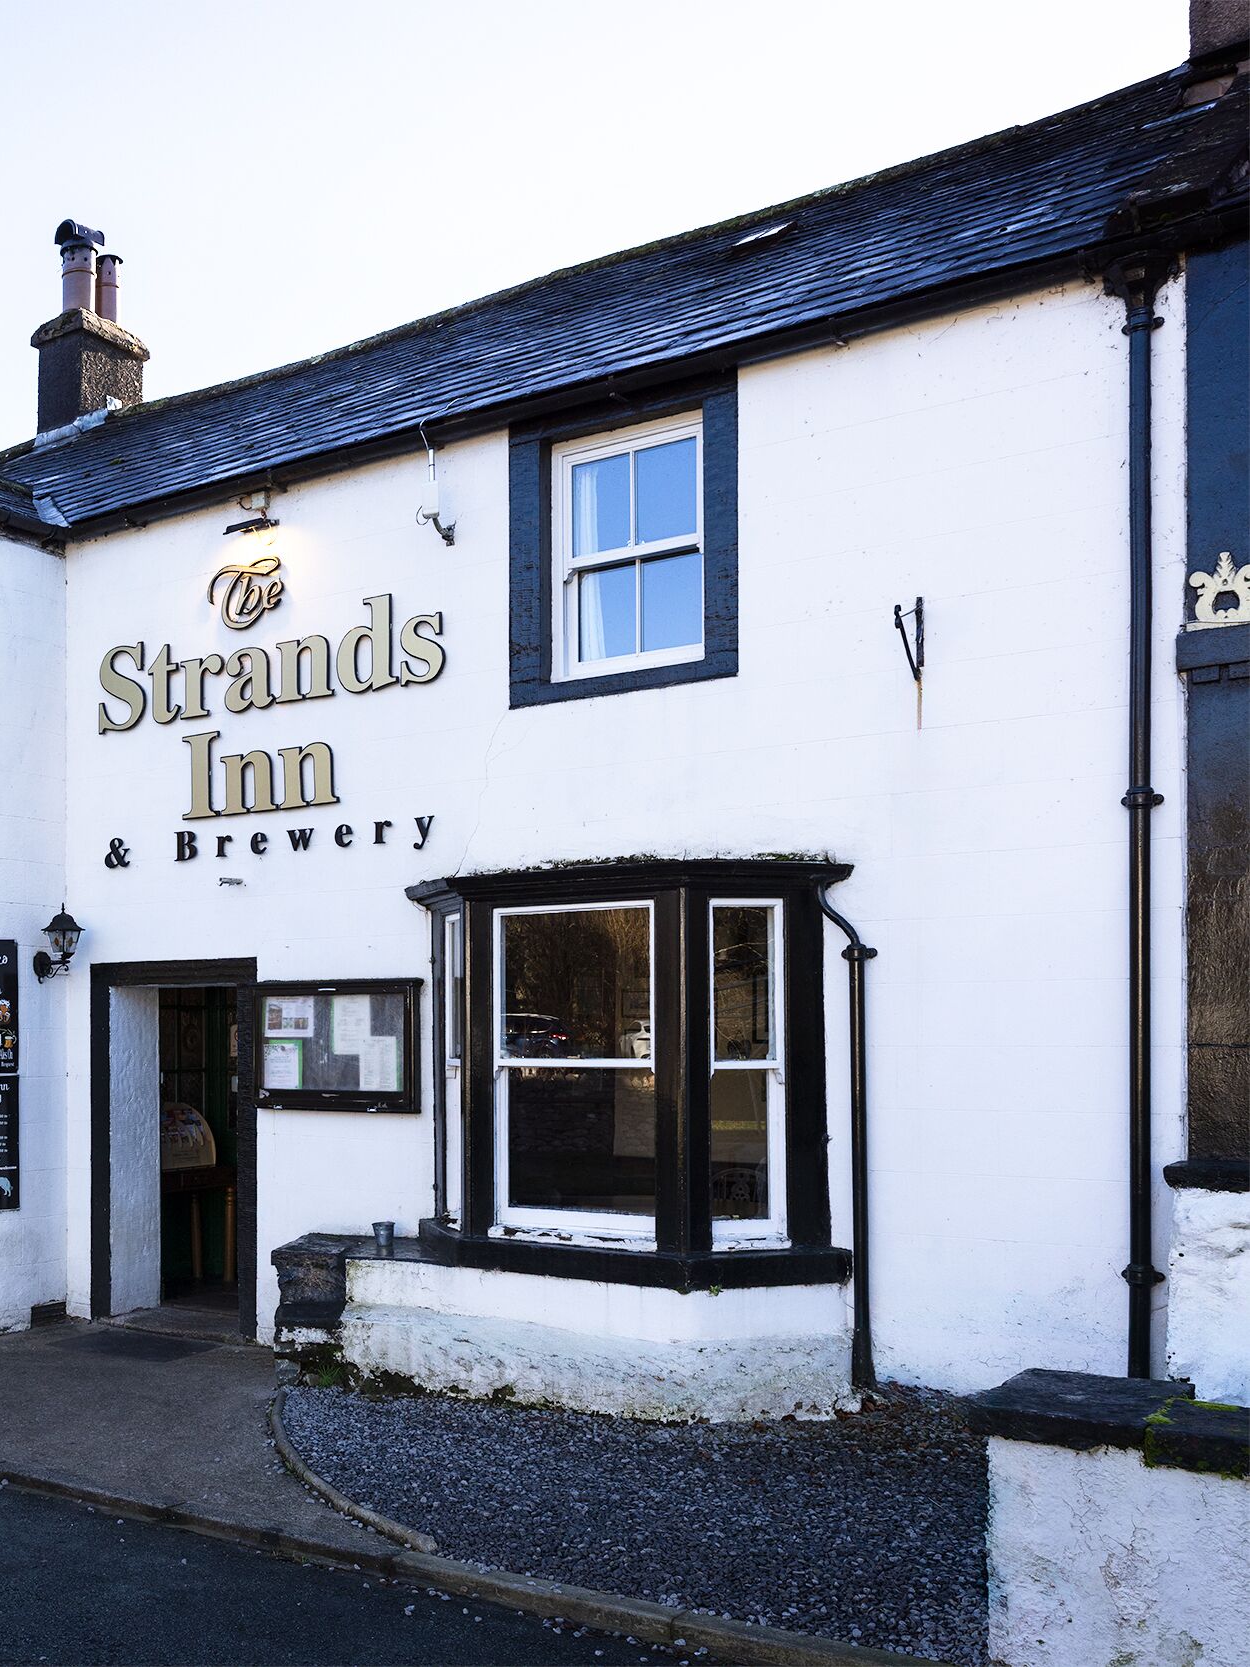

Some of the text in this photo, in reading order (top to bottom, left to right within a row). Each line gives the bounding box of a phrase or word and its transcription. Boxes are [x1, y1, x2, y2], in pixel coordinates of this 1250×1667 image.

[207, 556, 284, 630] The
[99, 593, 447, 735] Strands
[182, 731, 340, 820] Inn
[104, 815, 435, 869] & Brewery
